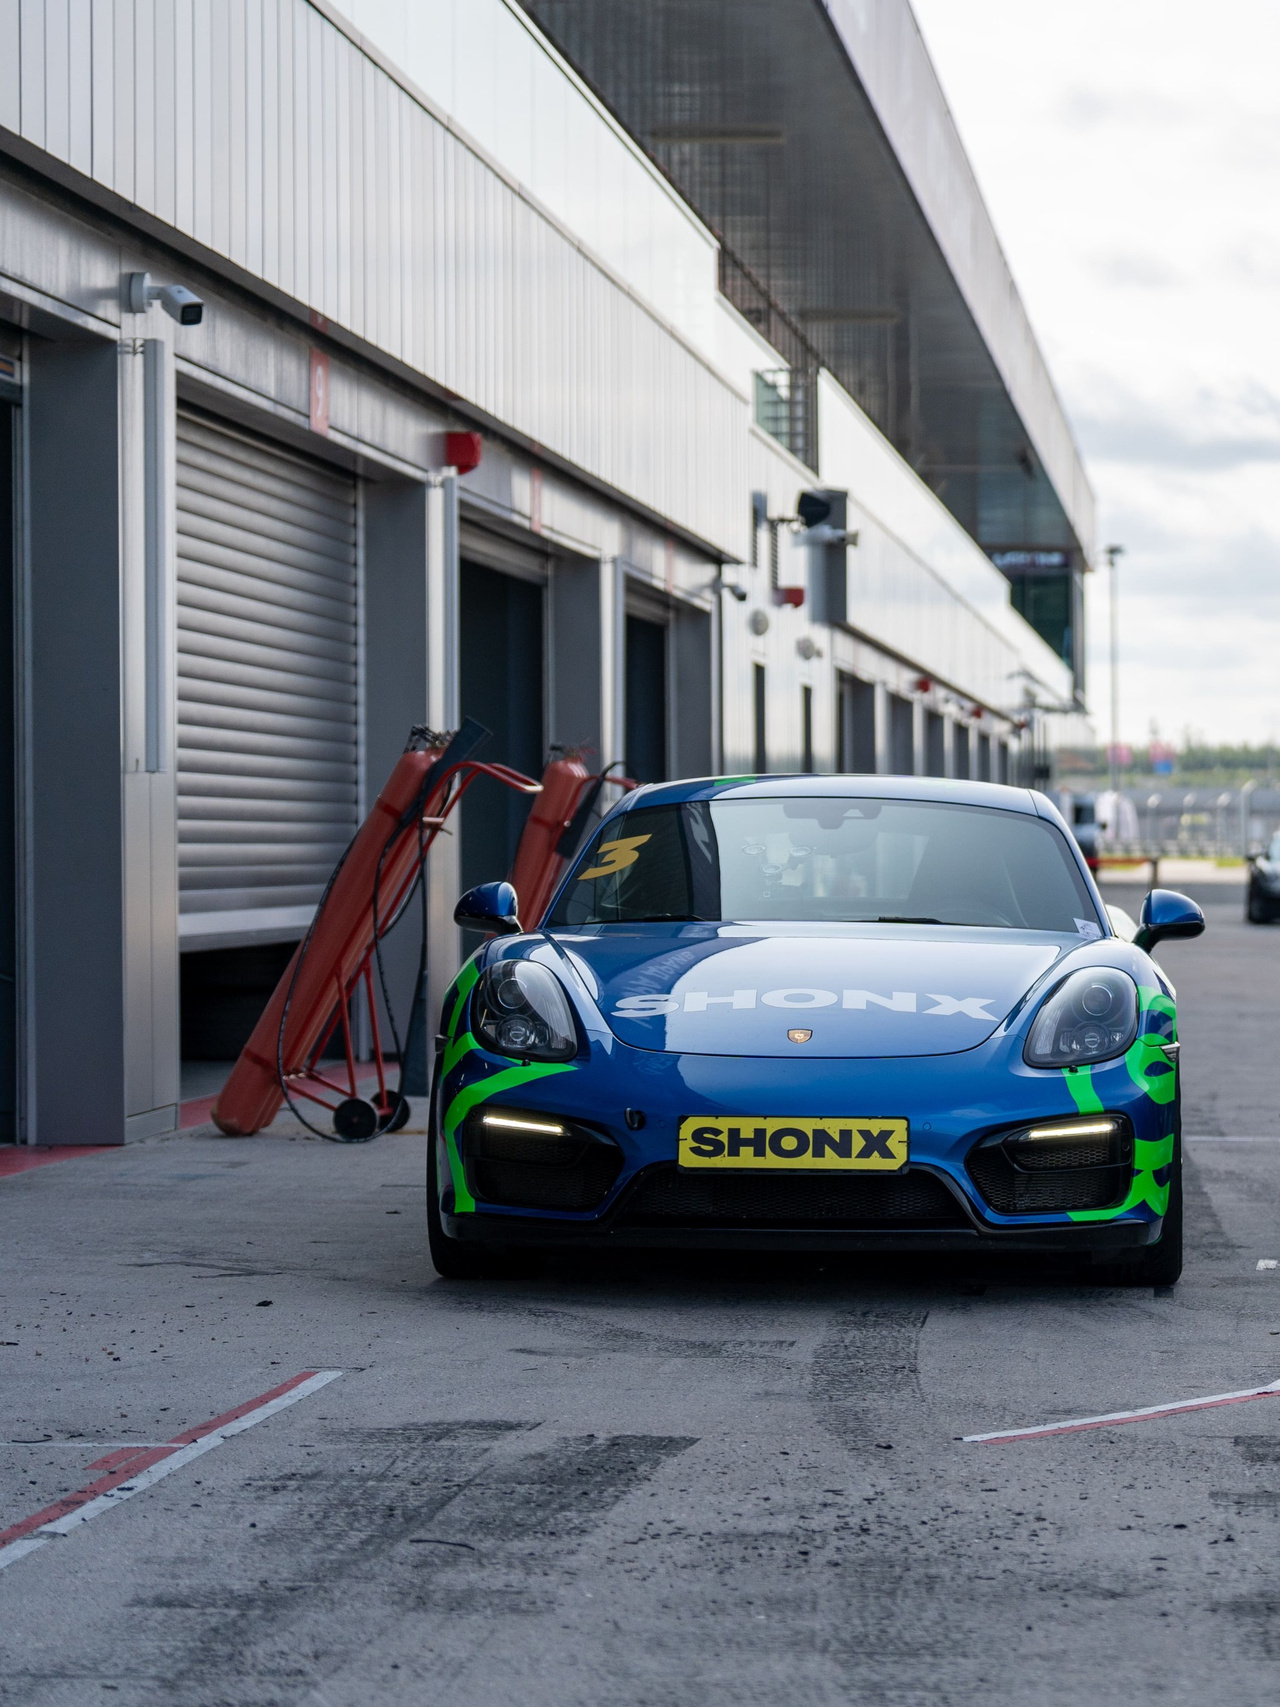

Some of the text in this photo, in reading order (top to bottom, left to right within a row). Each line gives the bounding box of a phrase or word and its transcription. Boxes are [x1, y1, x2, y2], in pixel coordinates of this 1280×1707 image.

[577, 833, 653, 880] 3
[610, 988, 1000, 1022] SHONX
[689, 1126, 898, 1160] SHONX
